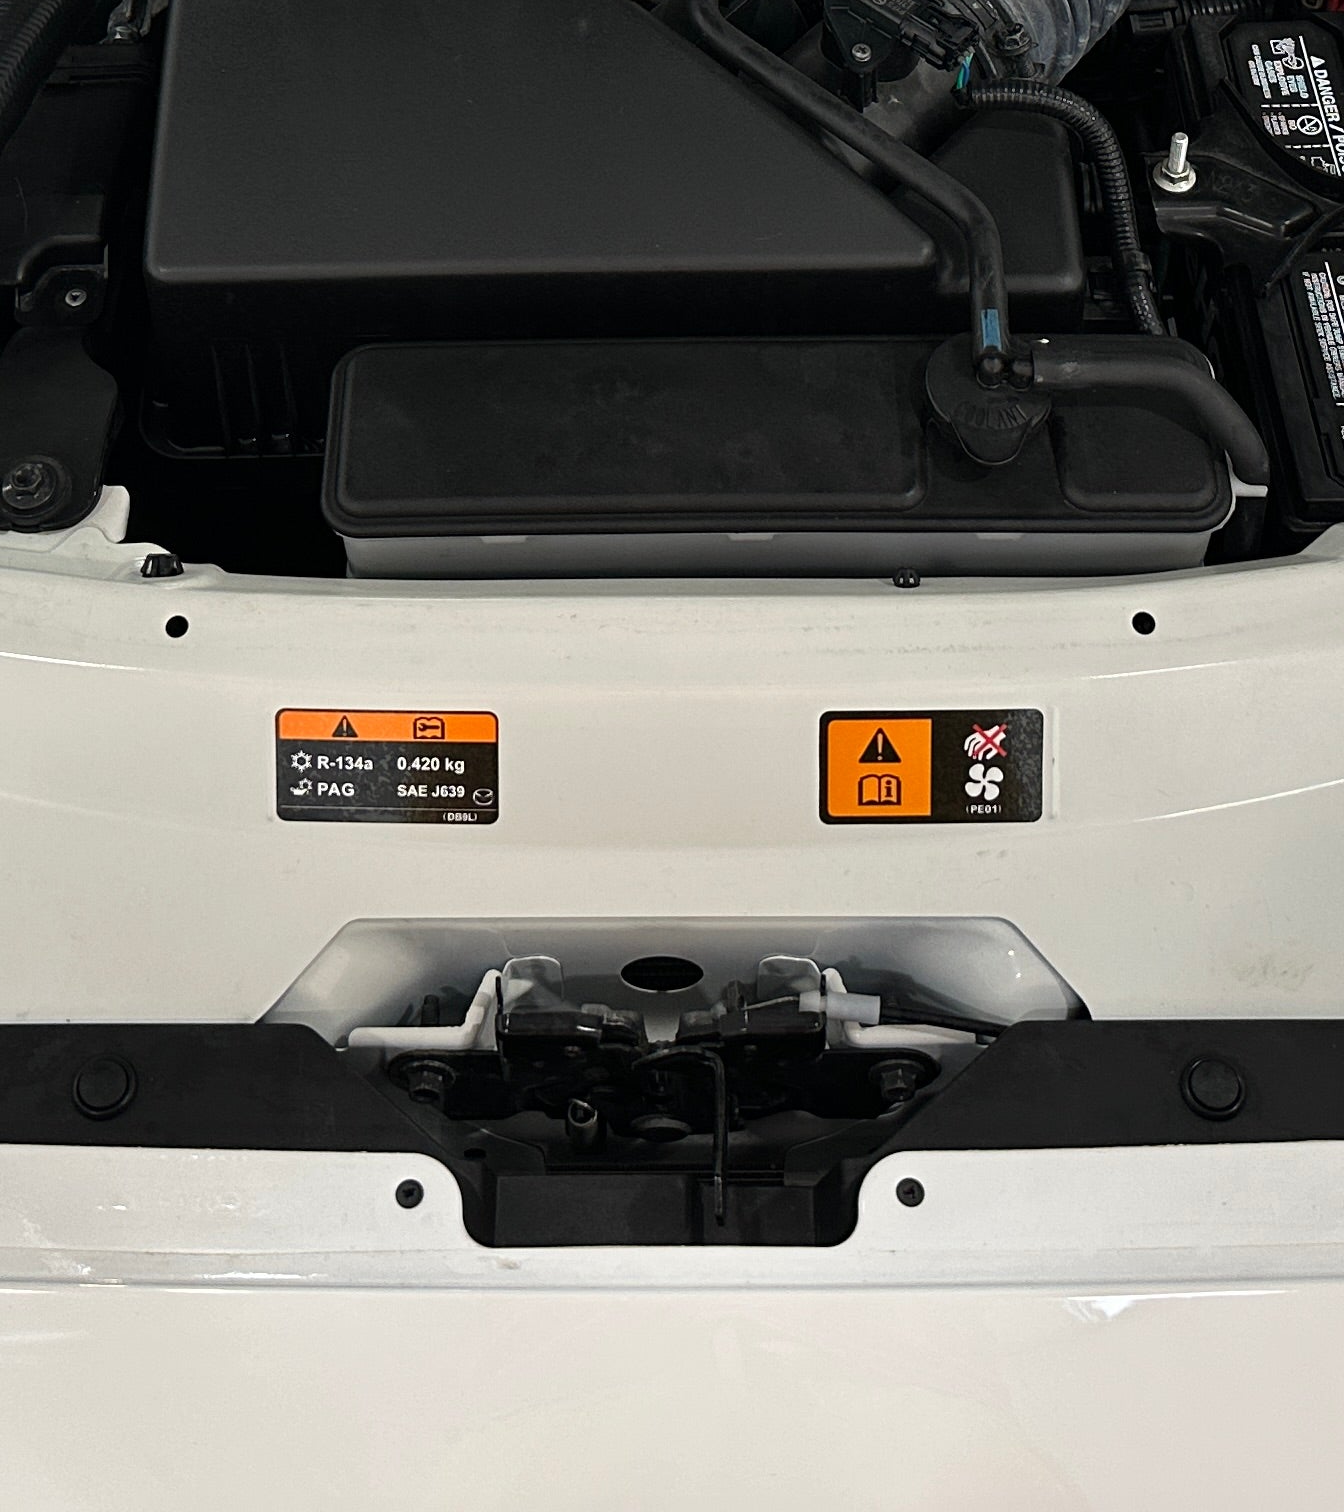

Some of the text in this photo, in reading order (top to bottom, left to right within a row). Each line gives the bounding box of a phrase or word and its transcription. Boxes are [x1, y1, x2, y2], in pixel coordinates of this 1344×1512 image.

[1314, 69, 1341, 122] DANGER
[317, 756, 465, 774] R-134a 0.420 kg
[317, 783, 466, 798] PAG SAE J639
[966, 804, 1002, 815] (PE01)
